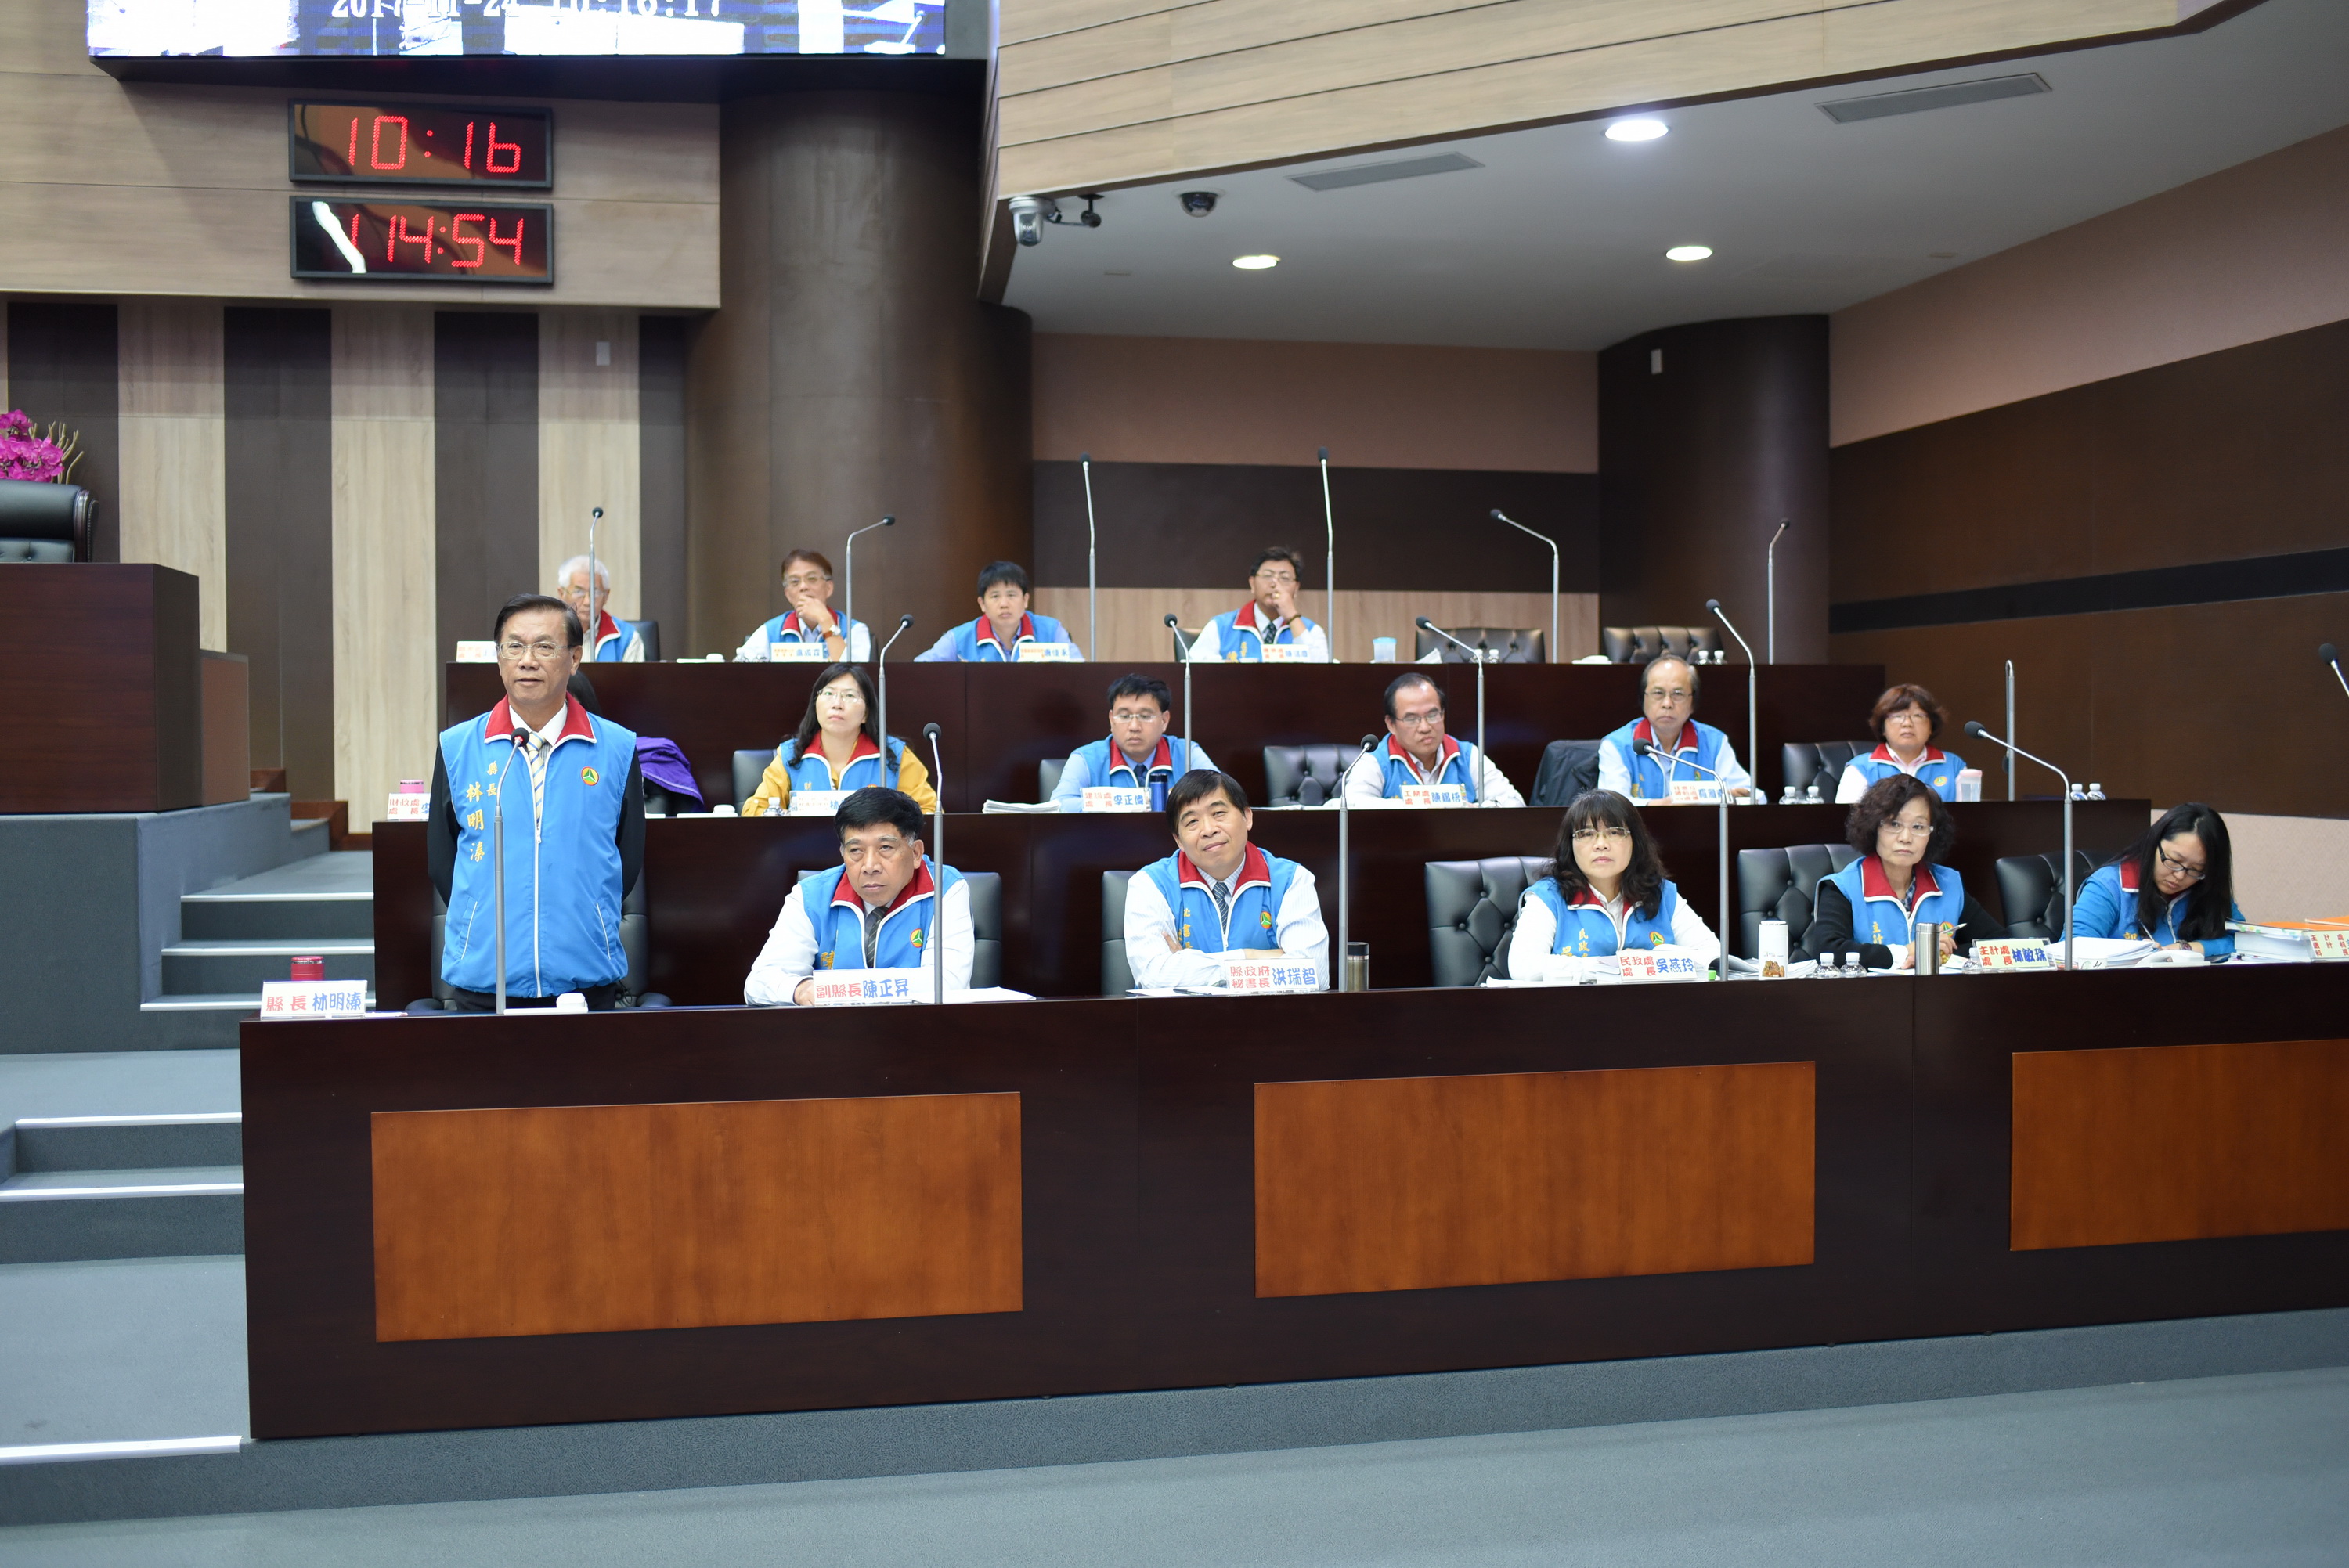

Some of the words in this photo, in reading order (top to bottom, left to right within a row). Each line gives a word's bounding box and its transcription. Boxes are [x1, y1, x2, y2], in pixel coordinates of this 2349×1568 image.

[348, 116, 521, 173] 10:16
[486, 761, 498, 797] 縣長
[1979, 945, 2011, 956] 主計處
[1619, 955, 1655, 966] 民政處
[1622, 966, 1658, 977] 處長
[1656, 957, 1694, 973] 吳燕玲
[1230, 965, 1270, 977] 縣政府
[1272, 967, 1317, 986] 洪瑞智
[816, 982, 862, 999] 副縣長
[265, 995, 308, 1012] 縣長
[312, 991, 362, 1012] 林明溱
